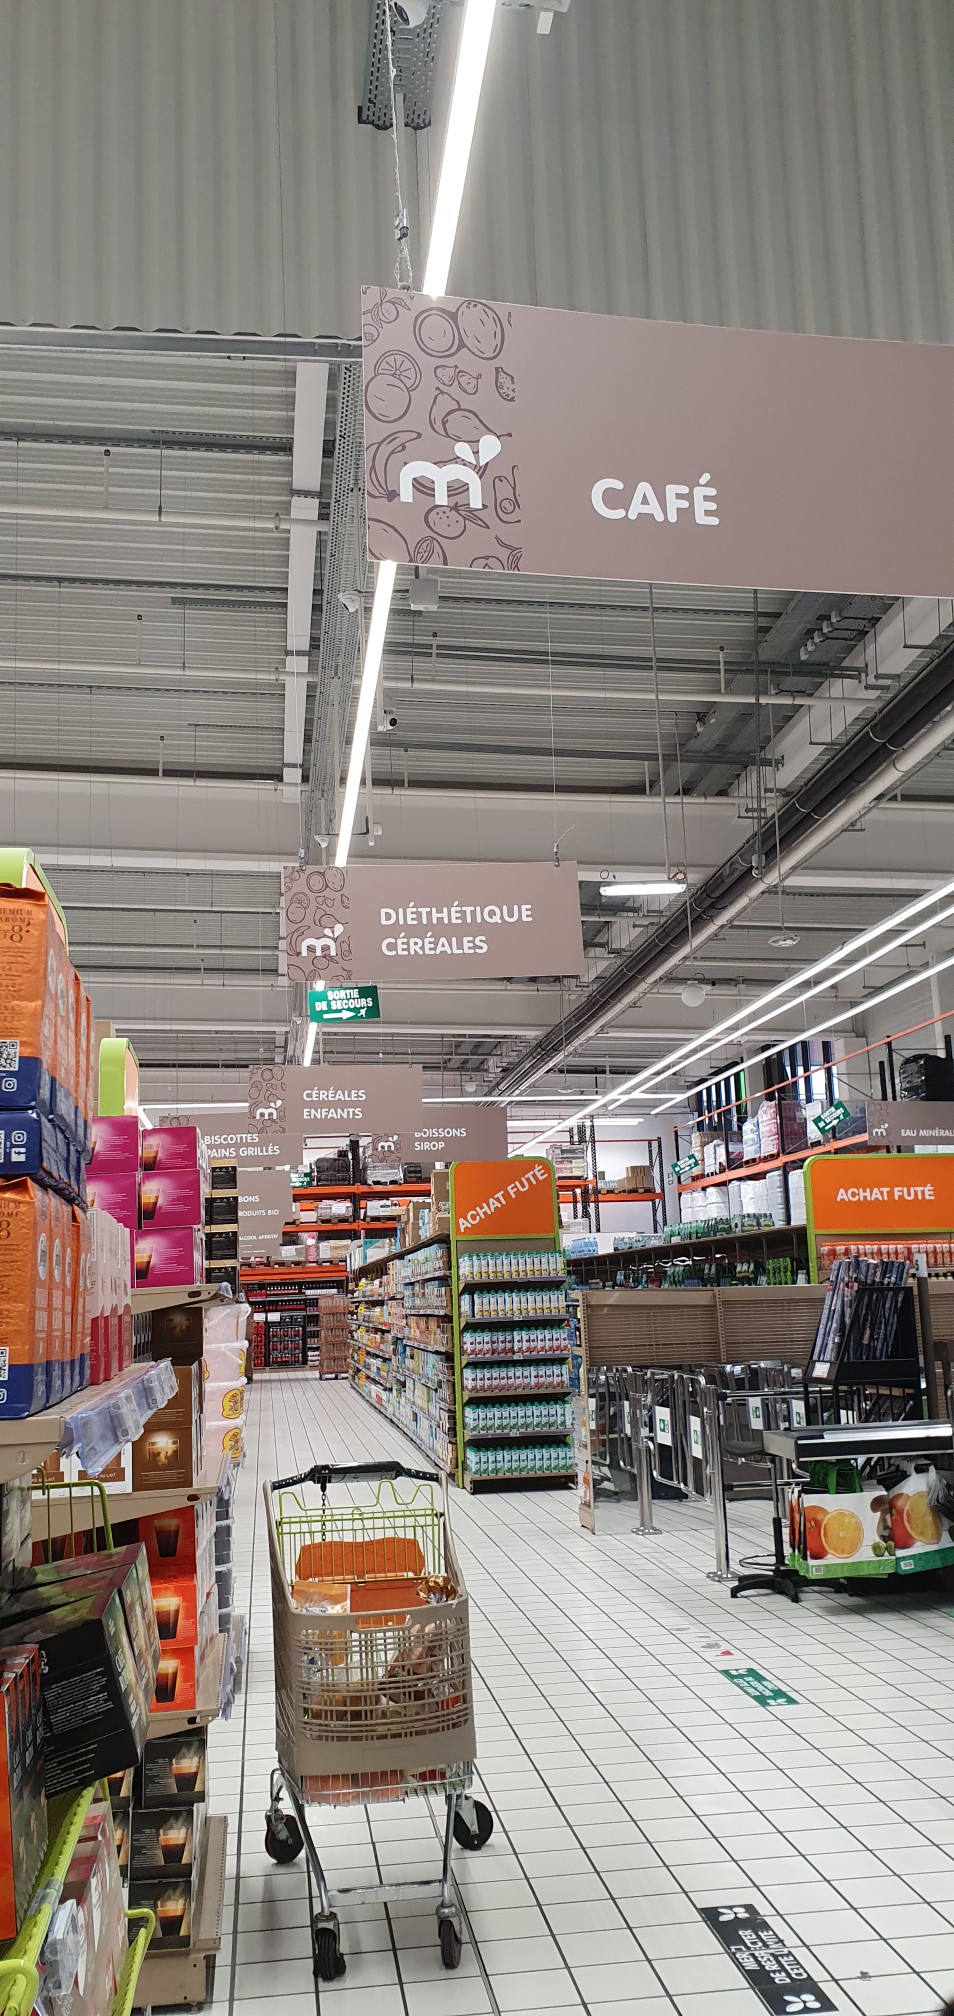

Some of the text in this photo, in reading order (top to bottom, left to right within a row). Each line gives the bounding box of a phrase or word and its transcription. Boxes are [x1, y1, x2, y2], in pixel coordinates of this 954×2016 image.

[590, 472, 720, 527] CAFÉ
[379, 901, 534, 926] DIÉTHÉTIQUE
[380, 931, 488, 957] CÉRÉALES
[327, 988, 360, 1001] SORTIE
[314, 997, 374, 1012] DE SECOURS
[302, 1086, 367, 1101] CÉRÉALES
[303, 1107, 363, 1120] ENFANTS
[204, 1133, 259, 1145] BISCOTTES
[900, 1126, 954, 1137] EAU MINÉRAL
[239, 1142, 280, 1157] GRILLÉS
[414, 1141, 446, 1151] SIROP
[458, 1163, 549, 1233] ACHAT FUTÉ
[836, 1183, 936, 1202] ACHAT FUTÉ
[238, 1208, 280, 1217] RODUITS BIO
[778, 1954, 809, 1980] CETTE
[769, 1971, 792, 1985] DE
